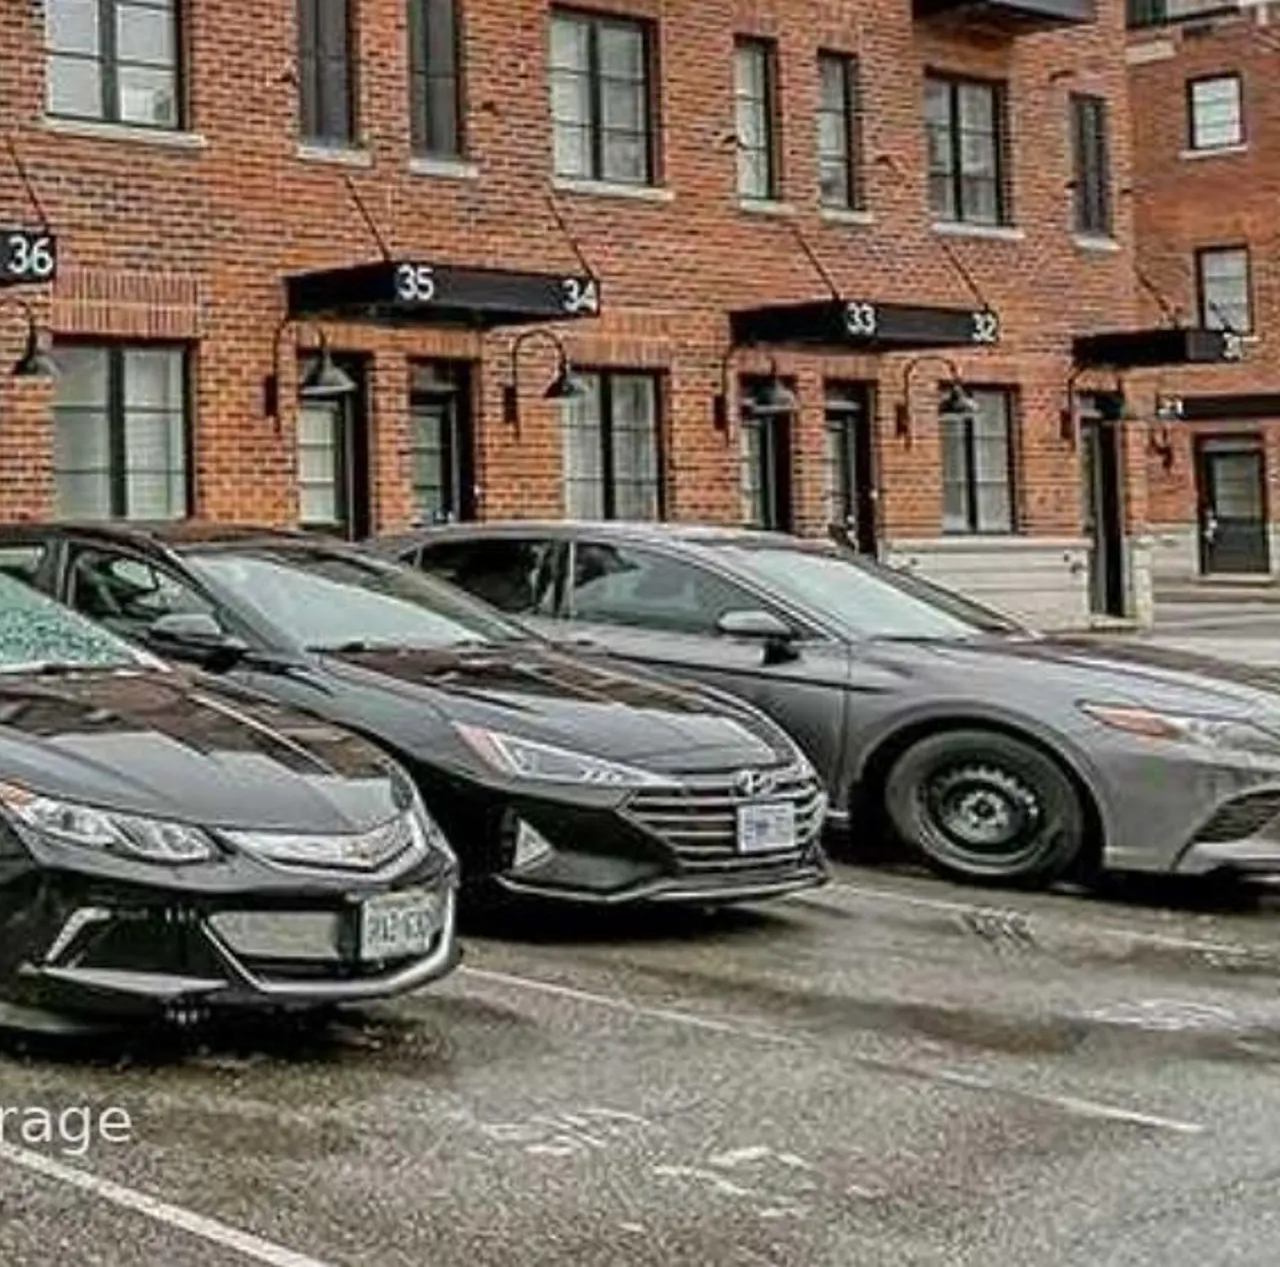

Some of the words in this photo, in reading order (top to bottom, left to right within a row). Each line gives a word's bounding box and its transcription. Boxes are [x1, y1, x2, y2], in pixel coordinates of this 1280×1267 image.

[7, 236, 53, 277] 36
[397, 263, 435, 301] 35
[562, 279, 598, 312] 34
[846, 302, 876, 335] 33
[971, 313, 998, 342] 32
